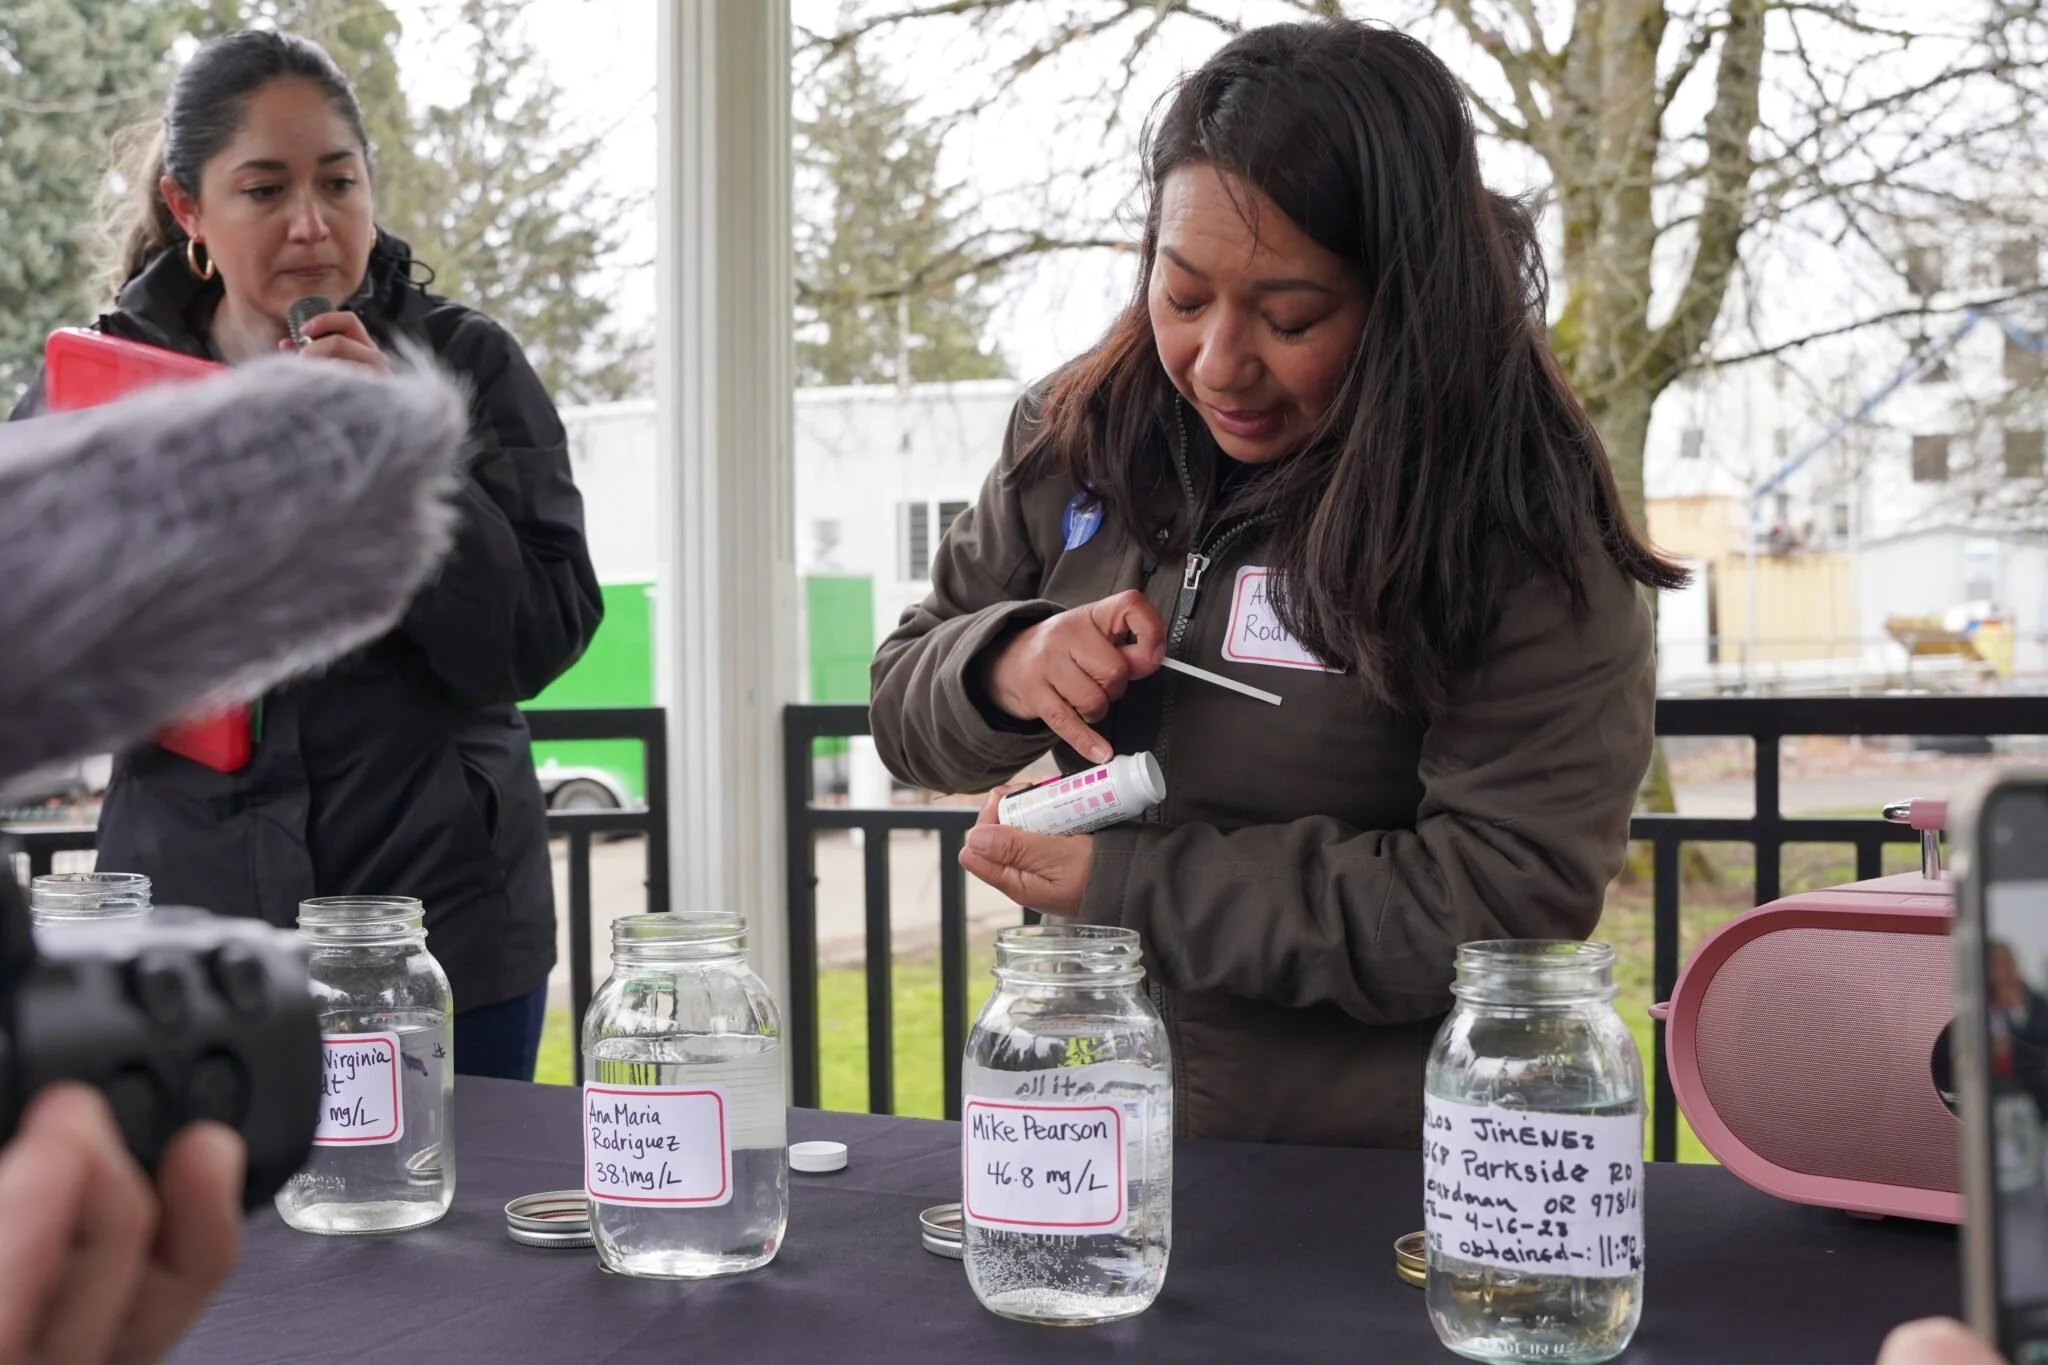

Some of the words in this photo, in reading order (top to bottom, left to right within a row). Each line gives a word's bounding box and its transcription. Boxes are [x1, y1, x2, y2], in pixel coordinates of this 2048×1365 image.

[1243, 612, 1290, 642] Rod
[321, 1047, 392, 1081] Virginia
[329, 1096, 380, 1127] mg/L
[589, 1098, 613, 1125] Ana
[614, 1103, 662, 1128] Maria
[972, 1113, 1019, 1143] Mike
[1023, 1114, 1107, 1142] Pearson
[591, 1127, 680, 1160] Rodriguez
[987, 1160, 1035, 1189] 46.8
[1046, 1159, 1109, 1195] mg/L
[1460, 1149, 1590, 1184] Parkside
[1426, 1178, 1519, 1213] oardman
[1544, 1194, 1577, 1215] OR
